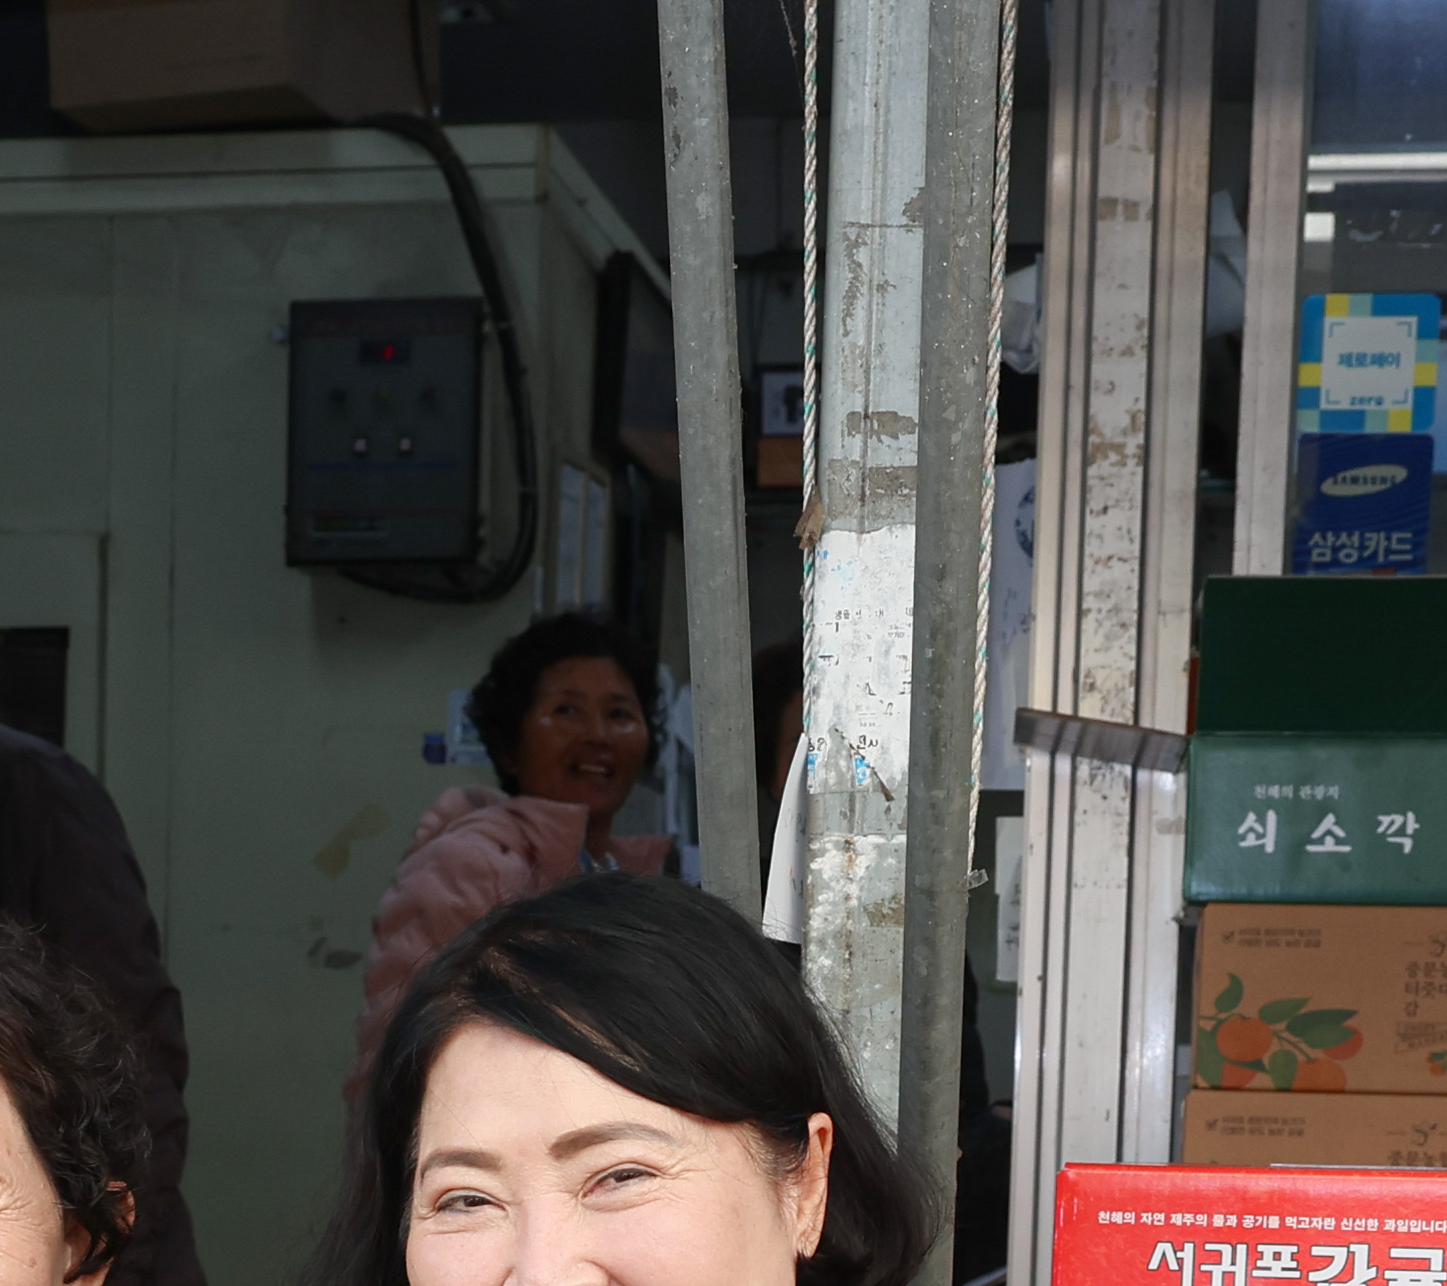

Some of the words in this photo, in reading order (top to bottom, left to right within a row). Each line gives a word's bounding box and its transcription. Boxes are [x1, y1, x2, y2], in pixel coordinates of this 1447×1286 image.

[1337, 352, 1401, 369] 제로페이
[1332, 473, 1398, 486] SAMSUNG
[1309, 531, 1413, 564] 삼성카드
[1097, 1210, 1134, 1225] 천혜의
[1139, 1211, 1165, 1226] 자연
[1169, 1212, 1207, 1227] 제주의
[1241, 1214, 1281, 1229] 공기를
[1285, 1215, 1335, 1231] 먹고자란
[1340, 1216, 1378, 1232] 신선한
